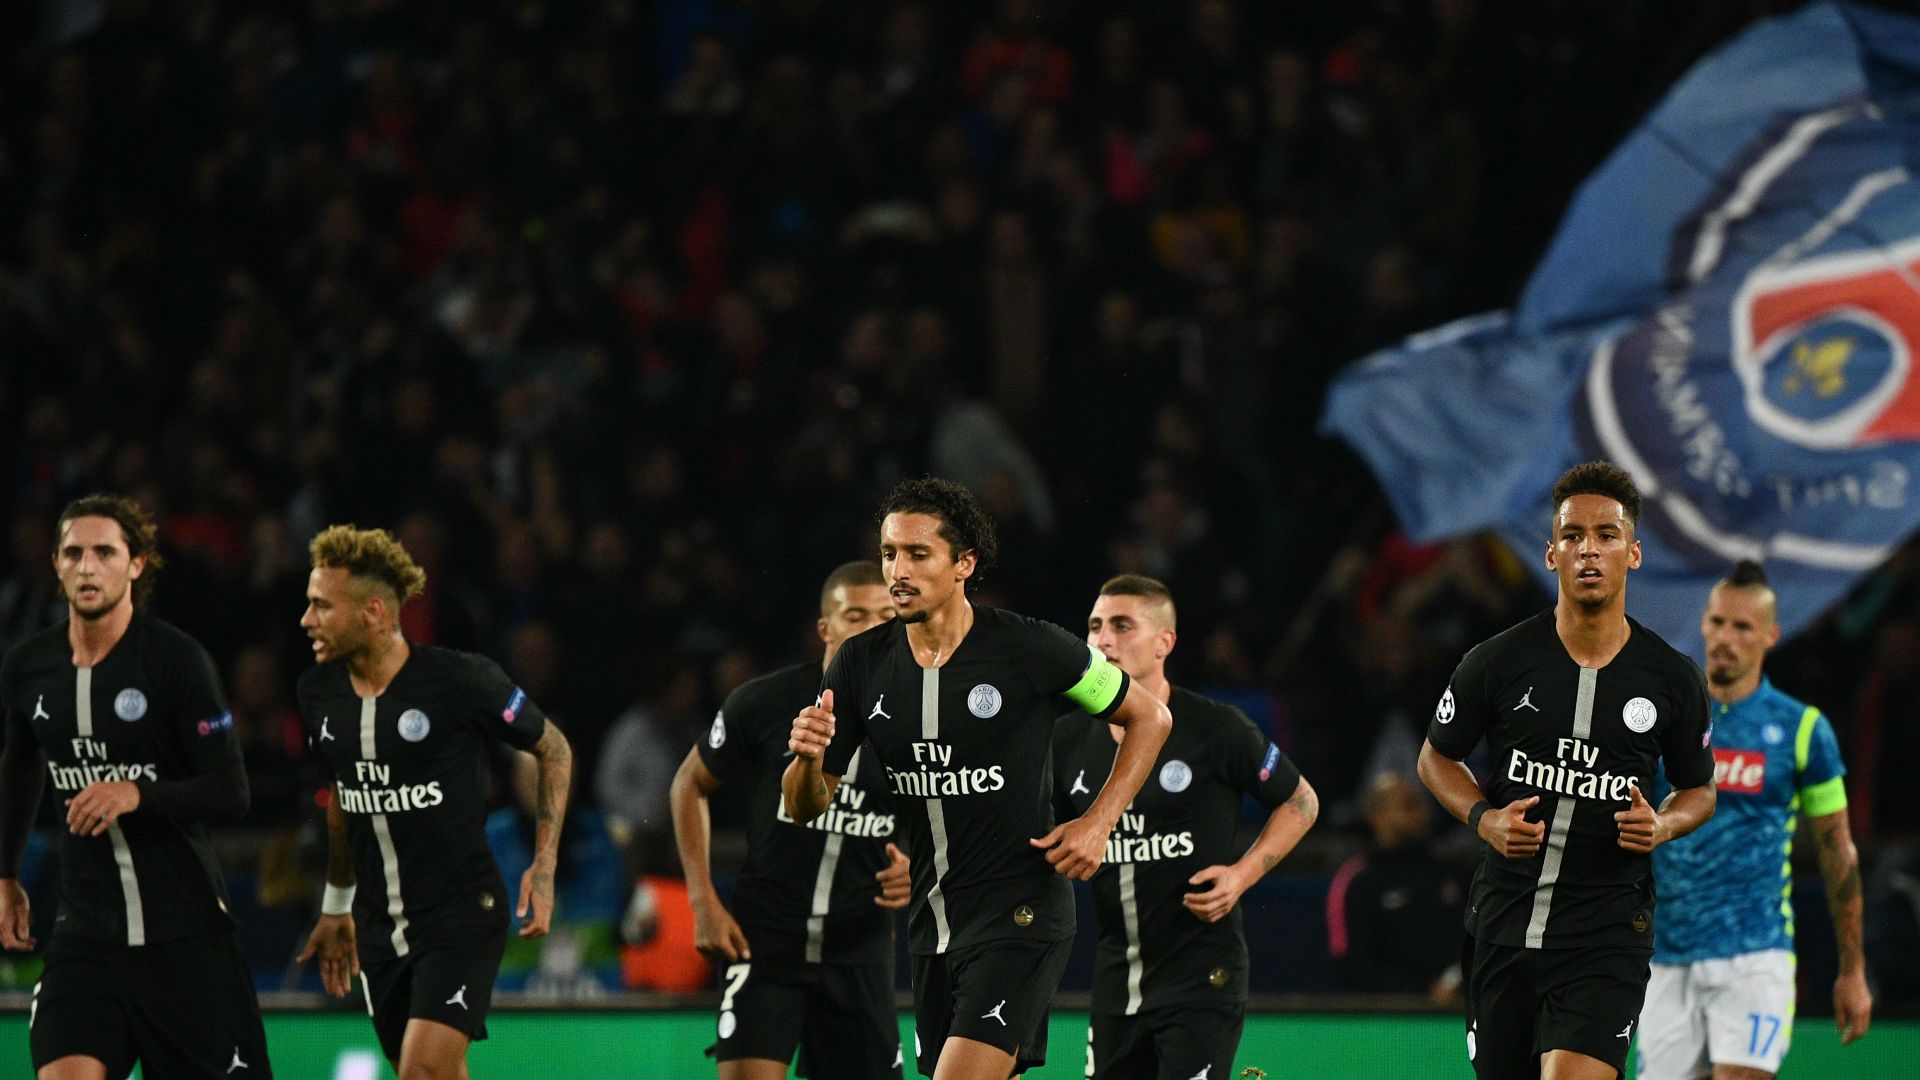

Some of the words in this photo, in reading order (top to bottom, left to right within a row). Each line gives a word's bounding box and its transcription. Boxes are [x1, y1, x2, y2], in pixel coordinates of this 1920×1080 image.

[71, 737, 107, 761] Fly
[911, 742, 952, 767] Fly
[1557, 738, 1600, 768] Fly
[48, 760, 158, 790] Emirates
[355, 761, 390, 785] Fly
[885, 764, 1005, 797] Emirates
[1507, 749, 1639, 801] Emirates
[1713, 754, 1765, 788] ete
[336, 780, 443, 814] Emirates
[834, 783, 866, 810] ly
[1112, 812, 1145, 835] ly
[1101, 831, 1194, 864] irates
[719, 963, 751, 1011] 7
[1747, 1013, 1781, 1059] 17
